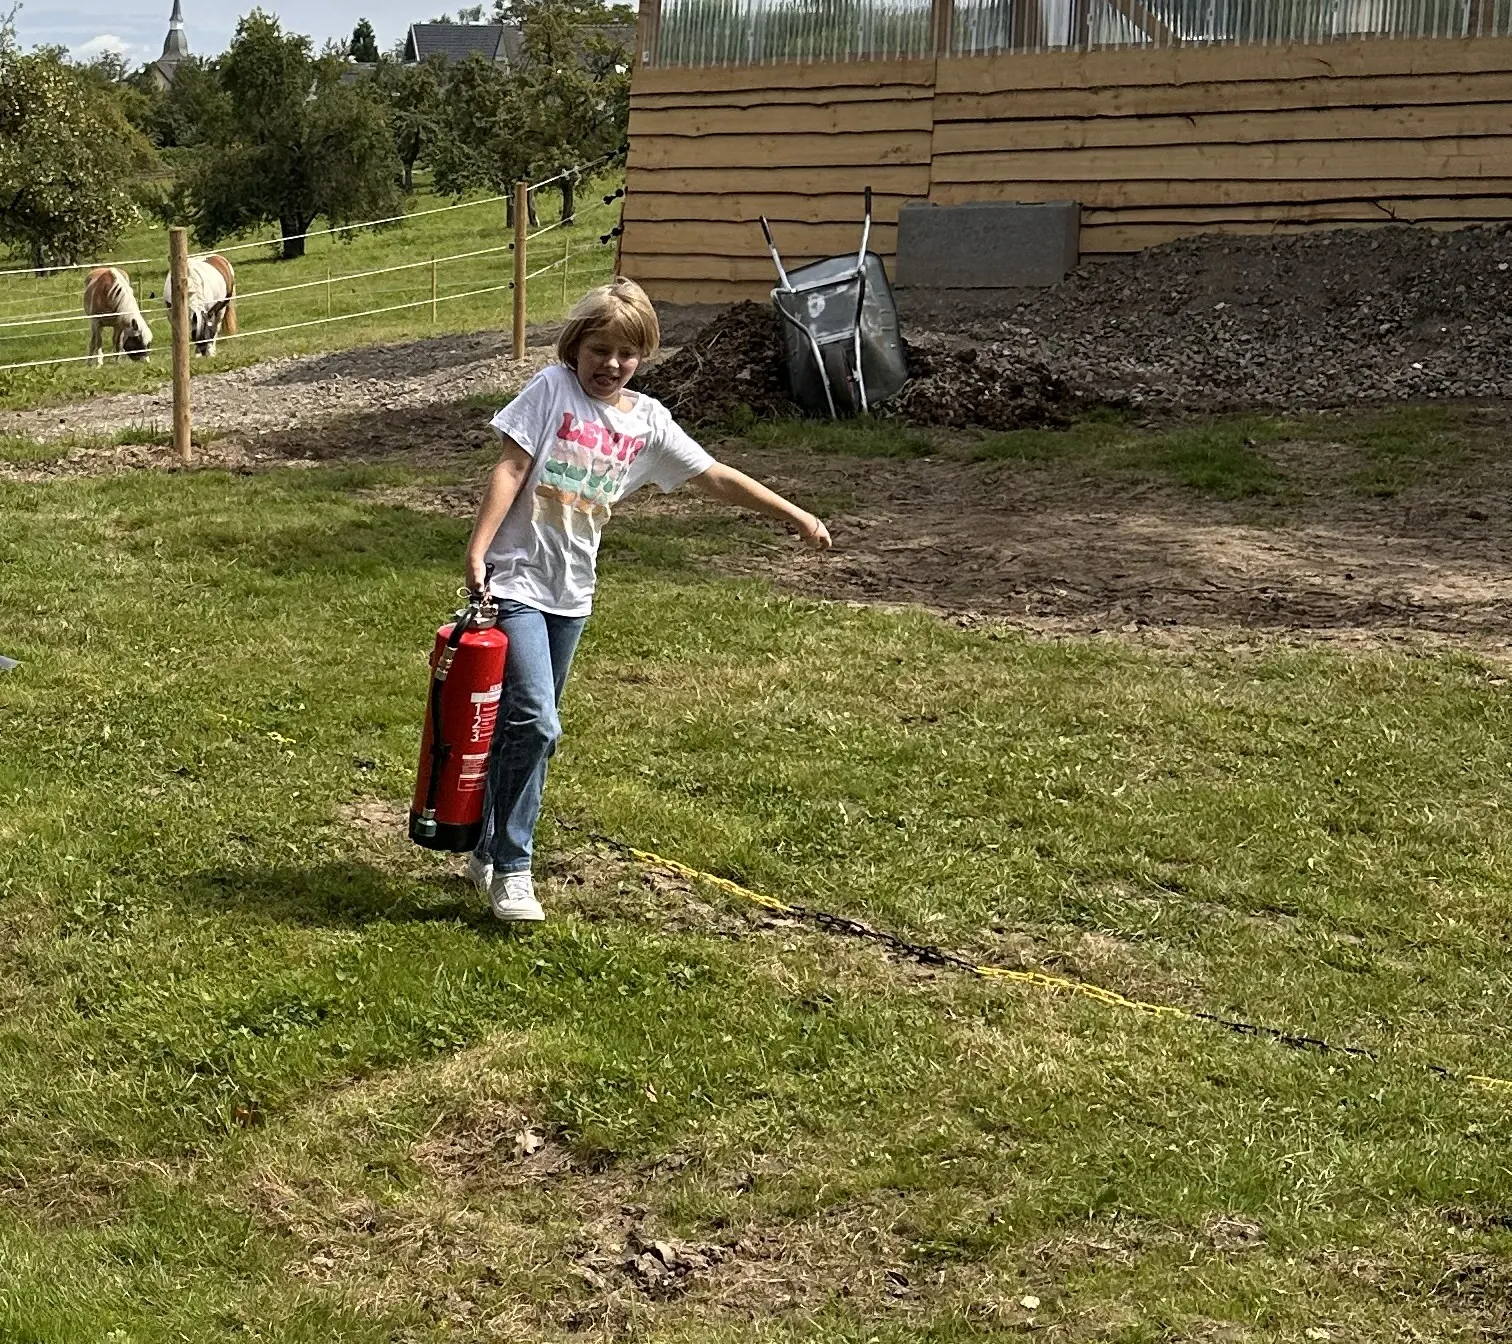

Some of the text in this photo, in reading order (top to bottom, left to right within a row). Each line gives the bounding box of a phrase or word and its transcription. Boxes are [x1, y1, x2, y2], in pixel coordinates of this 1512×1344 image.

[474, 702, 481, 716] 1
[472, 715, 482, 729] 2
[470, 728, 481, 743] 3
